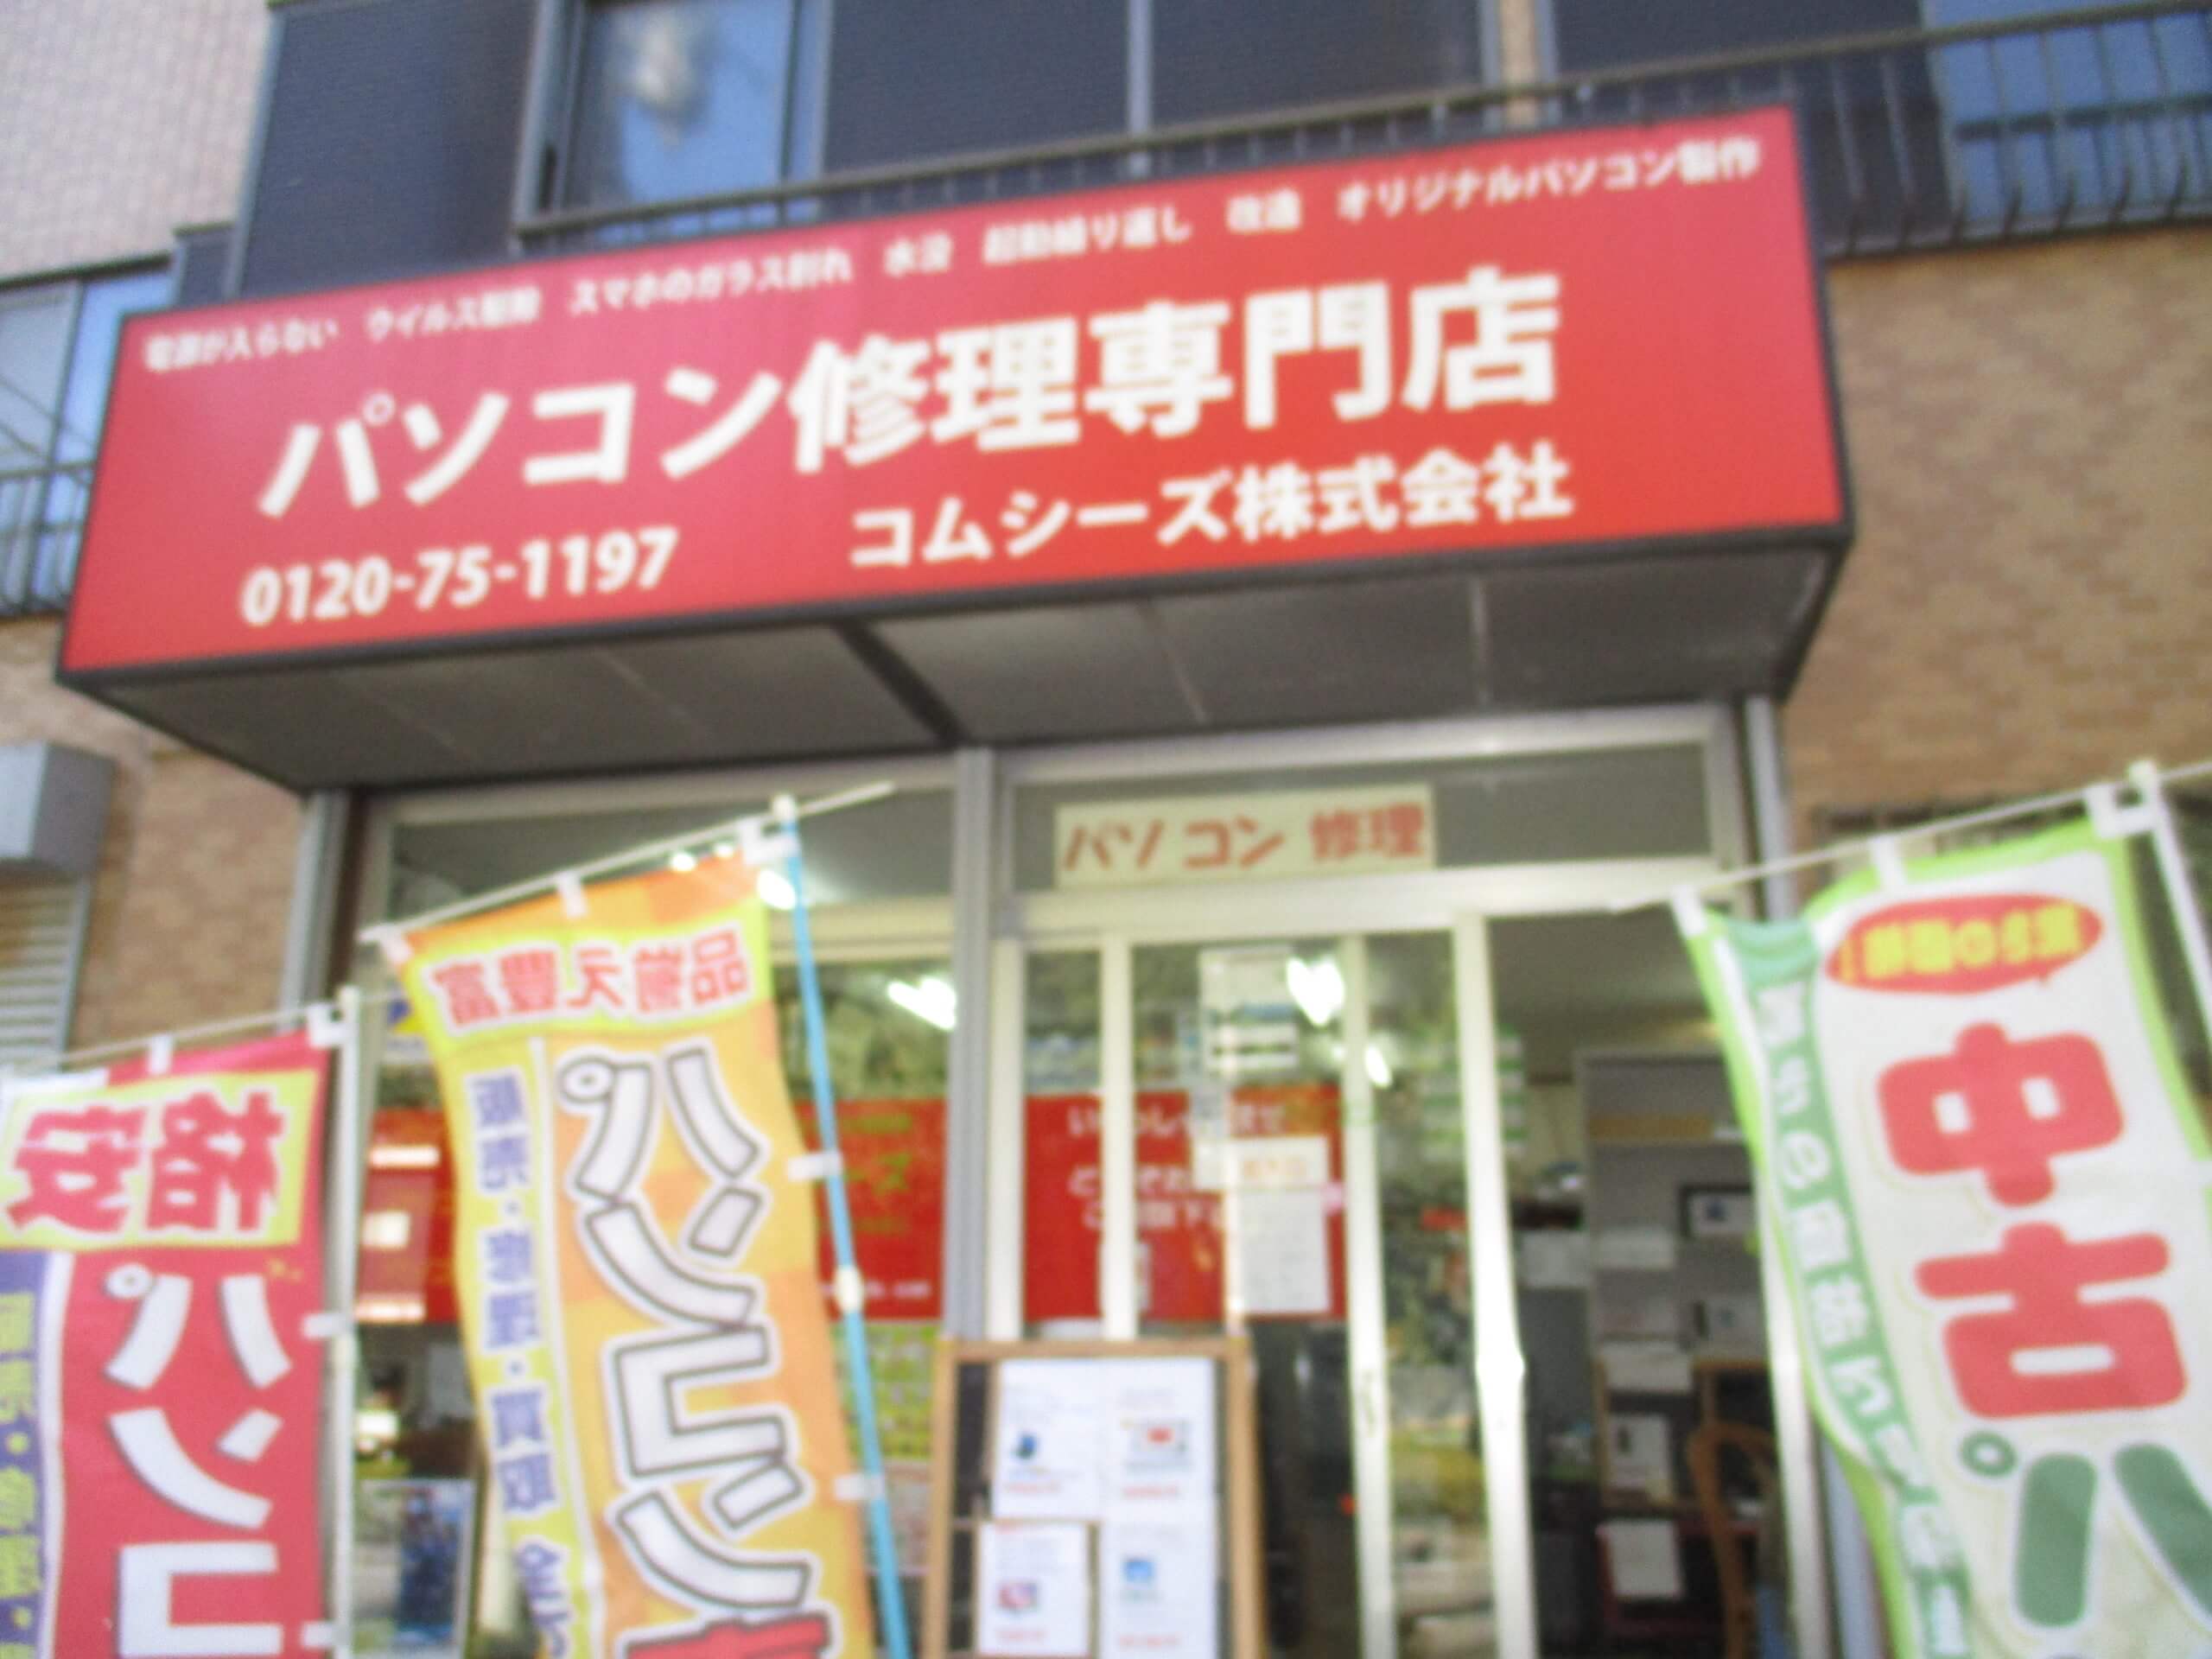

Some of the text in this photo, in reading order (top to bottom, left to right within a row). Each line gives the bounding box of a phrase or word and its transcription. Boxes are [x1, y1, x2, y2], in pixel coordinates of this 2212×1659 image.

[567, 245, 855, 317] スマホのガラス割れ
[1338, 136, 1761, 221] オリジナルパソコン製作
[258, 265, 1561, 518] パソコン修理専門店
[851, 442, 1573, 567] コムシーズ株式会社
[240, 525, 679, 626] 0120-75-1197
[1063, 803, 1426, 871] パソコン 修理
